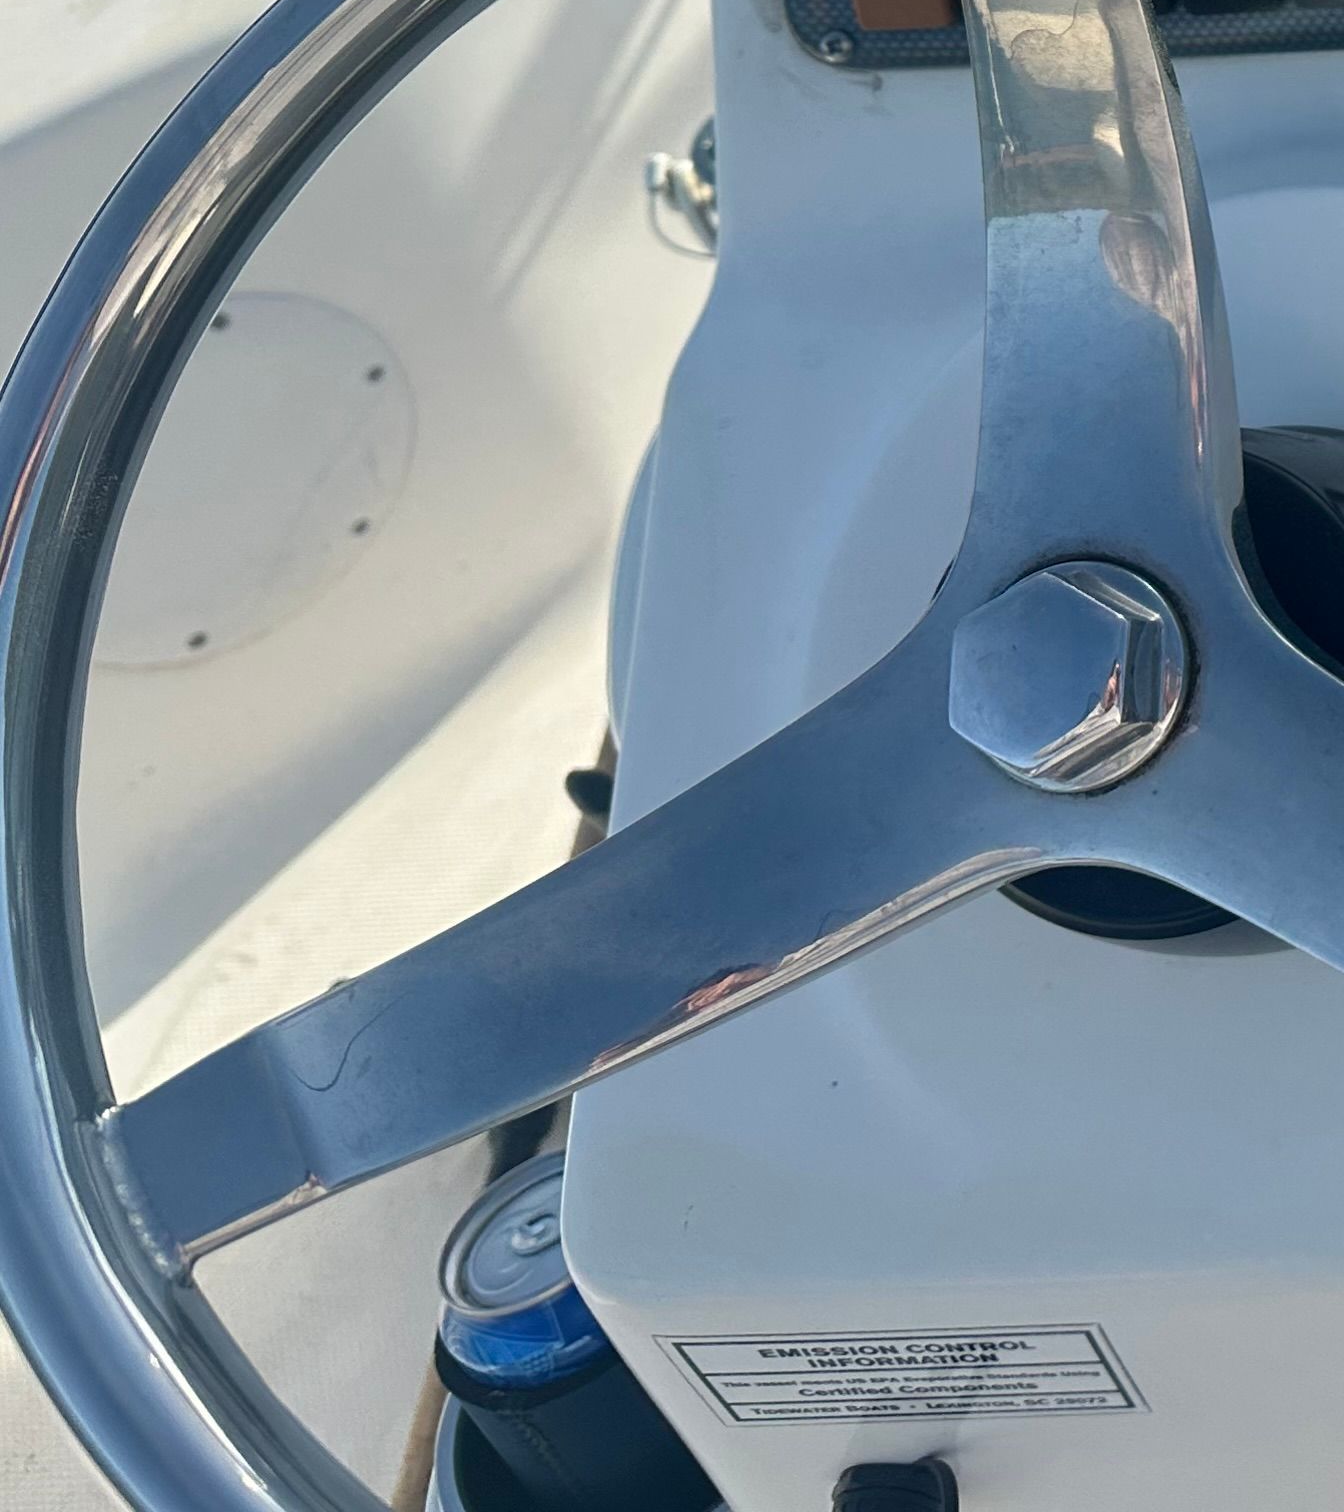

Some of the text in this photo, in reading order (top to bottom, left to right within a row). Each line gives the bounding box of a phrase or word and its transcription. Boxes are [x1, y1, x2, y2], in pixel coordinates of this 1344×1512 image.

[757, 1340, 1037, 1359] EMISSION CONTROL
[807, 1353, 1000, 1368] INFORMATION
[846, 1377, 867, 1385] US
[870, 1376, 901, 1384] EPA
[799, 1381, 1039, 1397] Certified Components
[1024, 1398, 1050, 1407] SC
